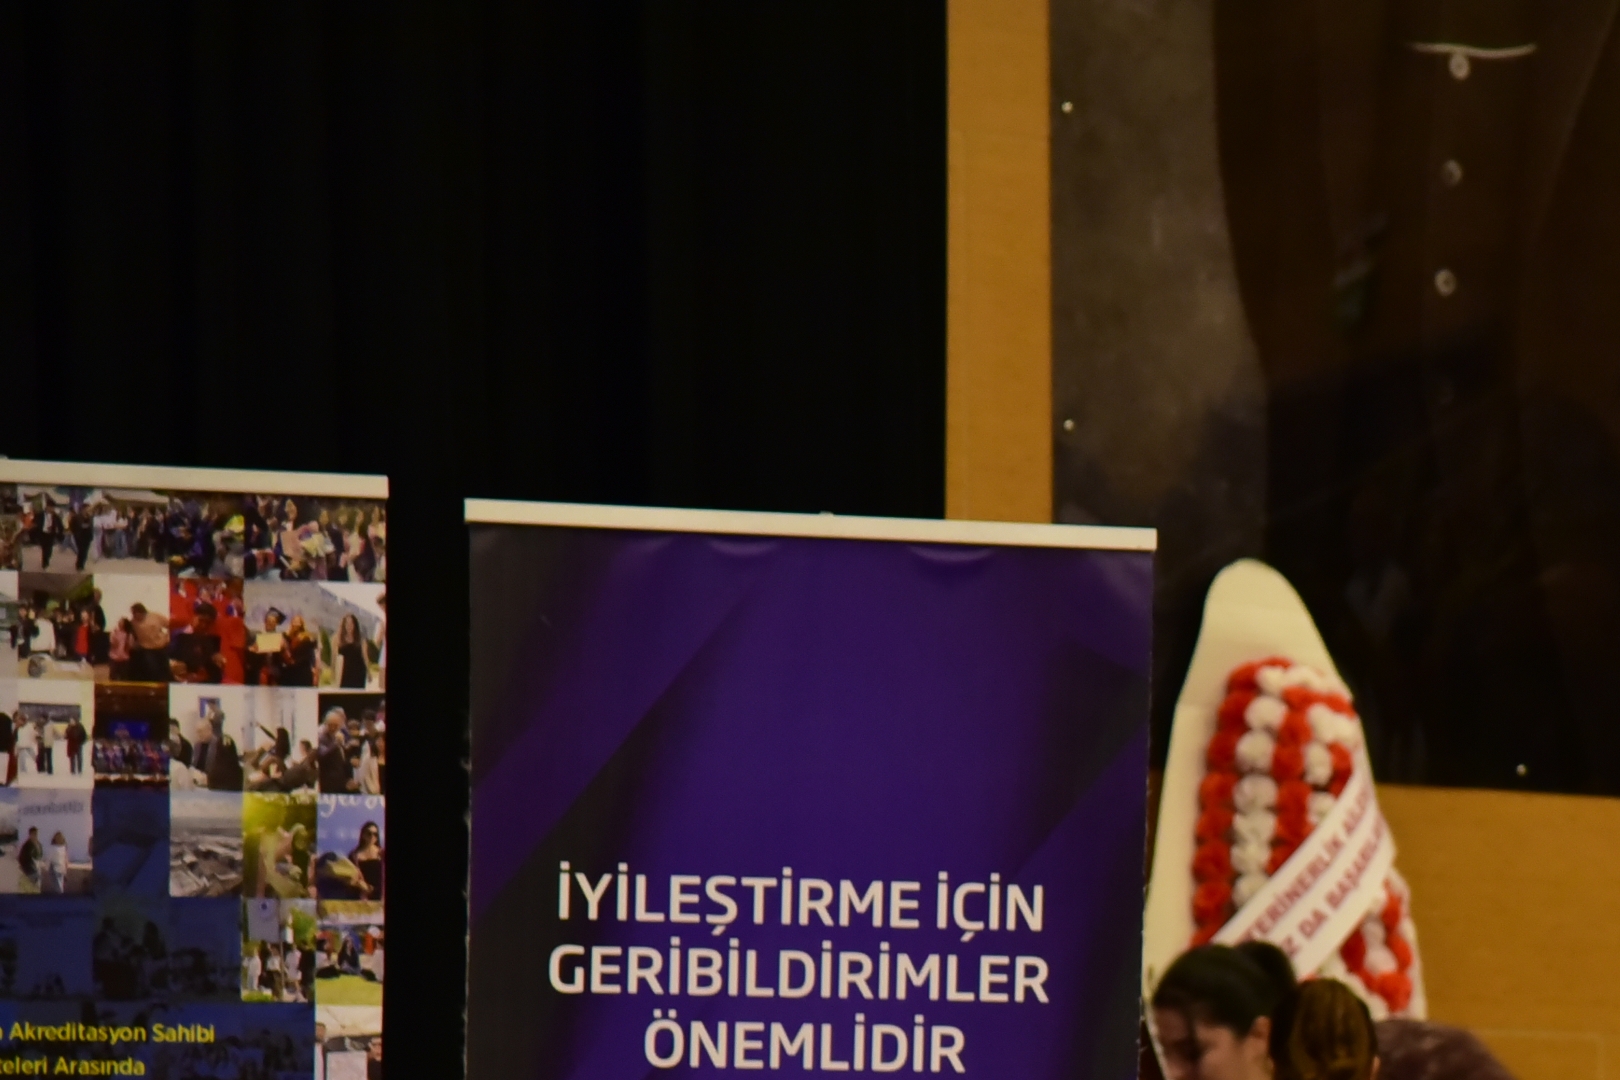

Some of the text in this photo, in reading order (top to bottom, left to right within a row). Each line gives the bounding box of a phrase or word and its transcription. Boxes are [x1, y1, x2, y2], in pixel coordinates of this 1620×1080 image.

[560, 861, 1043, 942] İYİLEŞTİRME İÇİN
[1298, 909, 1328, 939] DA
[549, 936, 1049, 1003] GERİBİLDİRİMLER
[10, 1022, 147, 1046] Akreditasyon
[153, 1023, 216, 1043] Sahibi
[644, 1008, 966, 1073] ÖNEMLİDİR
[54, 1056, 146, 1075] Arasında
